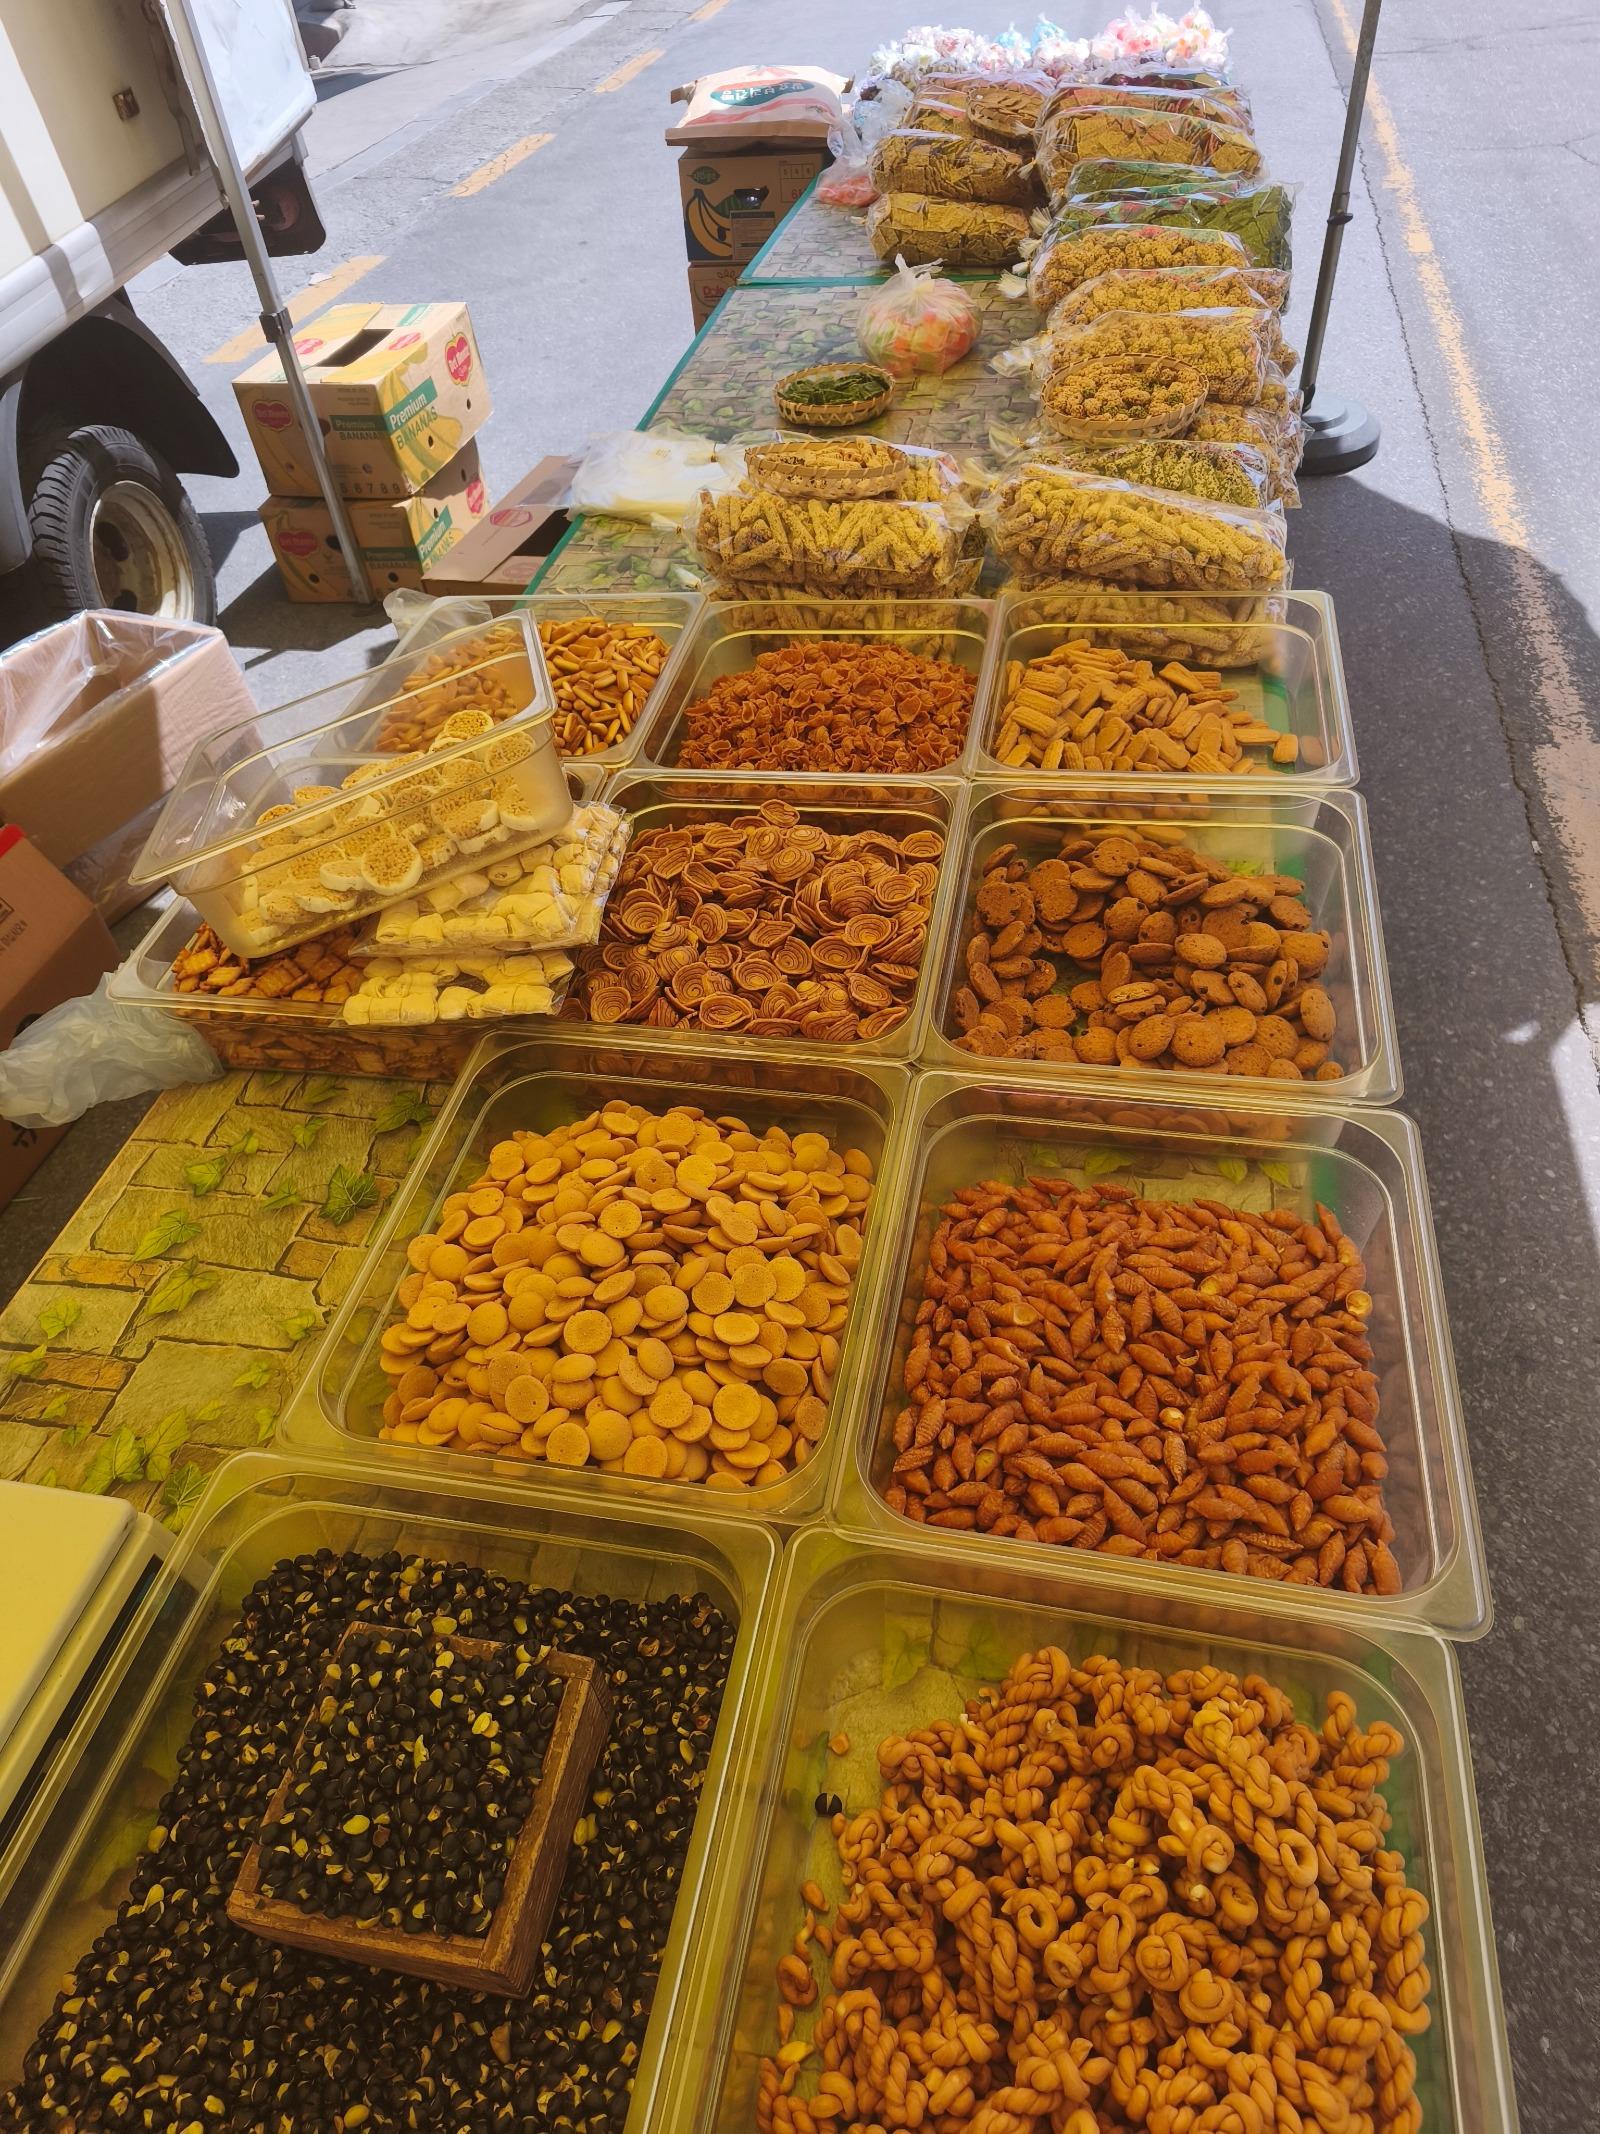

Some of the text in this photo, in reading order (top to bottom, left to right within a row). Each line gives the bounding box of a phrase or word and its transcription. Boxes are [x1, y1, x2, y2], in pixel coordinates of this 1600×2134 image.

[390, 393, 428, 430] Premium
[395, 406, 438, 450] BANANAS
[367, 483, 373, 494] 7
[418, 521, 447, 560] Premium
